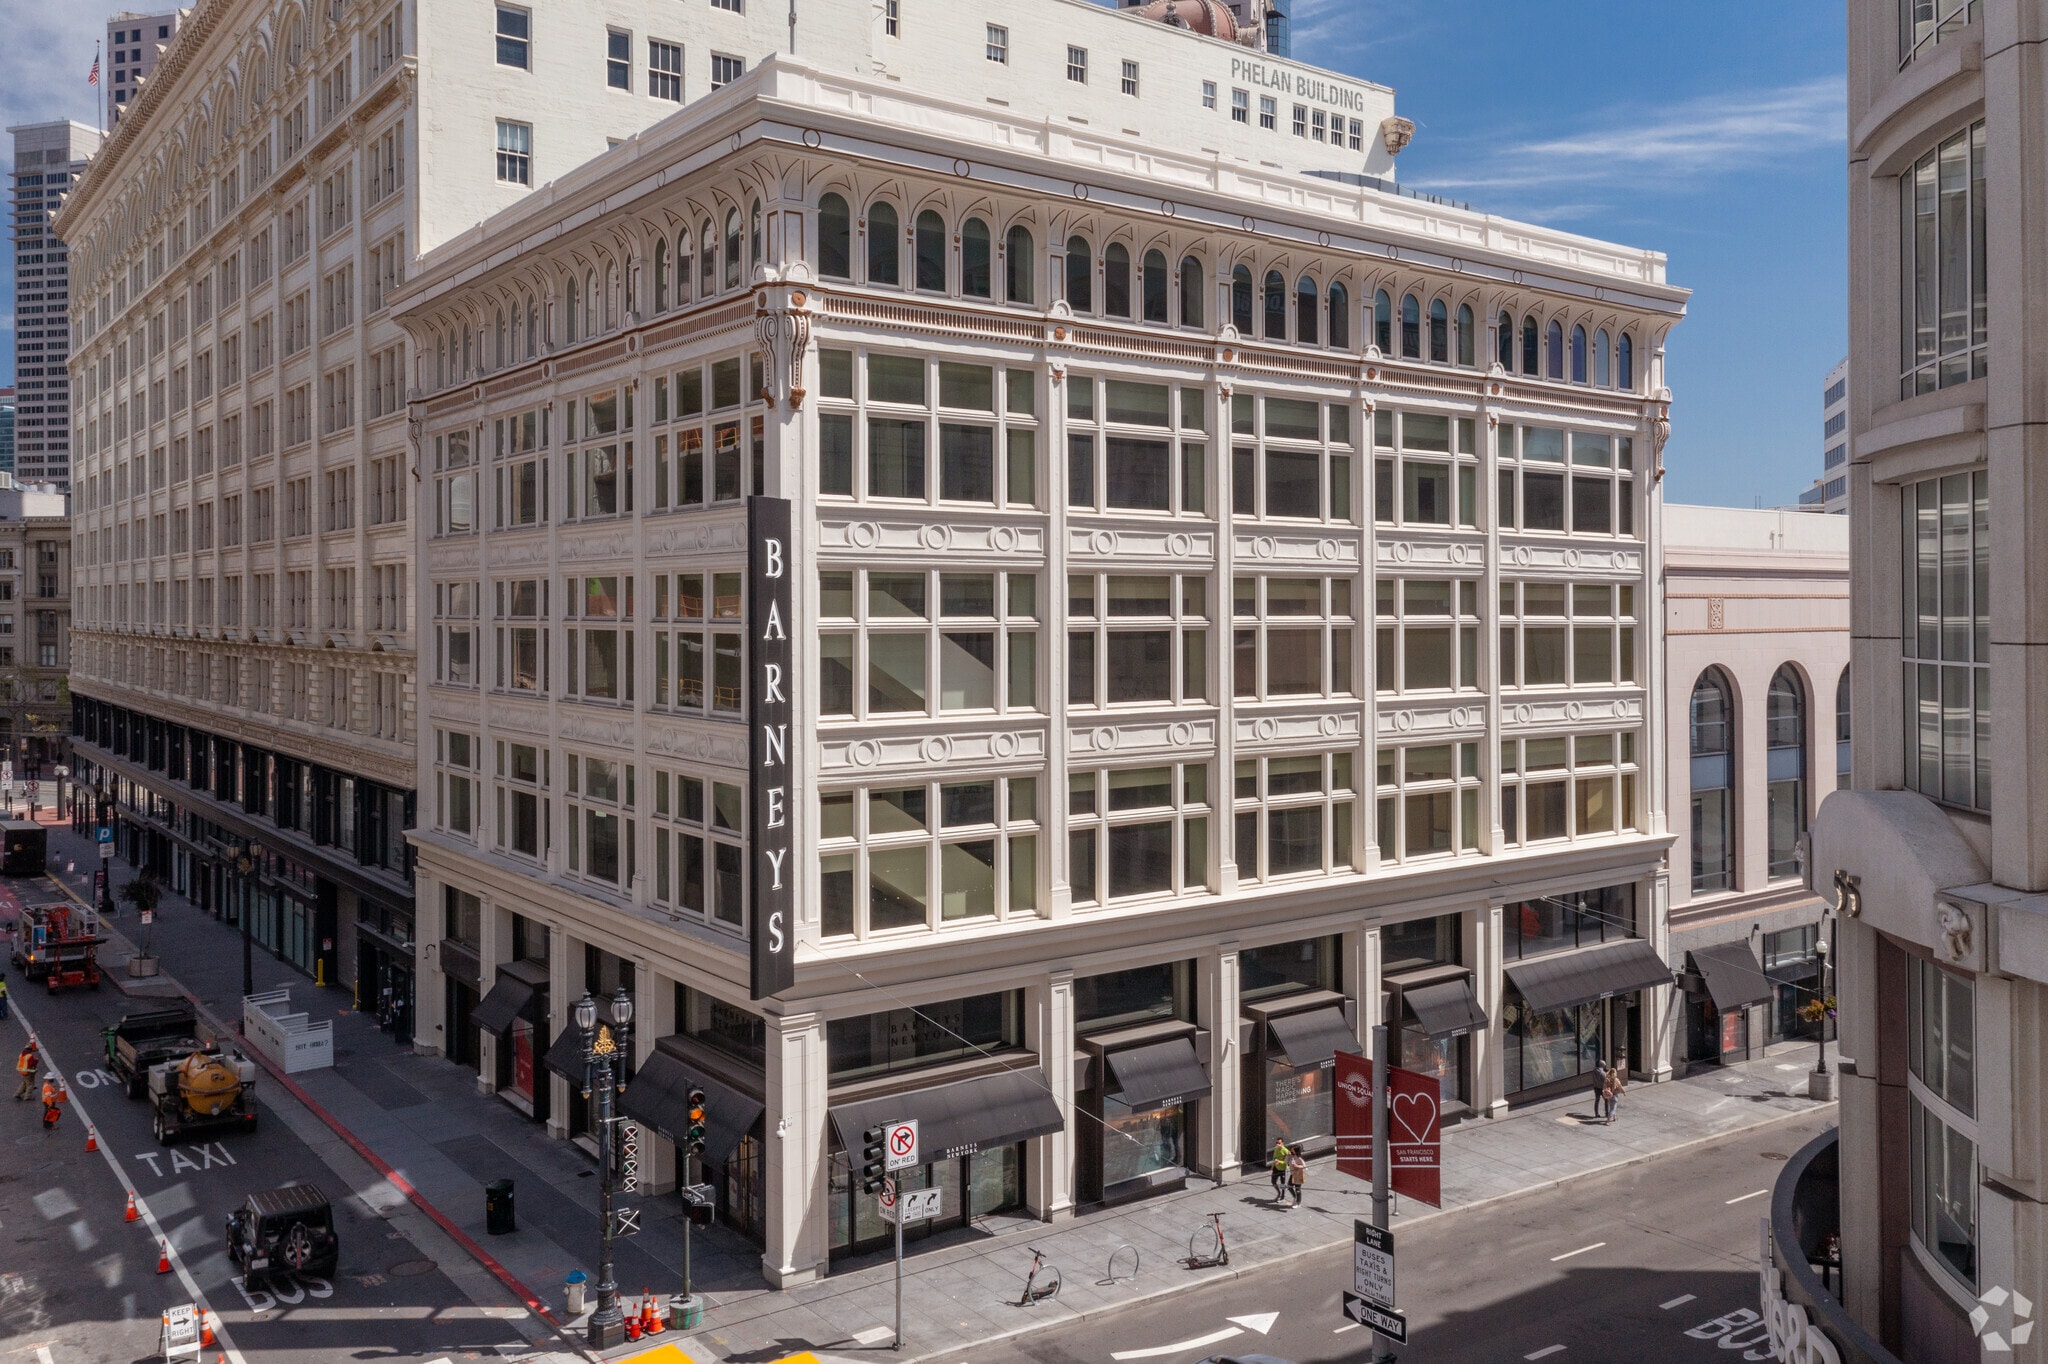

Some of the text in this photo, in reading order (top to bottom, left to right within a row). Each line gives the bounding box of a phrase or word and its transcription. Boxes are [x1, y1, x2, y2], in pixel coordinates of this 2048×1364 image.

[1231, 57, 1364, 112] PHELAN BUILDING
[763, 537, 787, 955] BARNEYS
[1337, 1081, 1373, 1097] UNION SQUA
[946, 1142, 978, 1154] BARNEYS
[135, 1142, 237, 1177] TAXI
[889, 1155, 915, 1167] ON RED
[886, 1208, 896, 1219] RED
[924, 1206, 939, 1214] ONLY
[1366, 1227, 1382, 1240] RIGHT
[1366, 1236, 1382, 1249] LANE
[1361, 1249, 1386, 1265] BUSES
[1359, 1257, 1388, 1275] TAXIS &
[1356, 1265, 1392, 1287] RIGHT TURNS
[1363, 1278, 1384, 1292] ONLY
[172, 1306, 192, 1318] KEEP
[1360, 1307, 1400, 1333] ONE WAY
[171, 1326, 194, 1338] RIGHT
